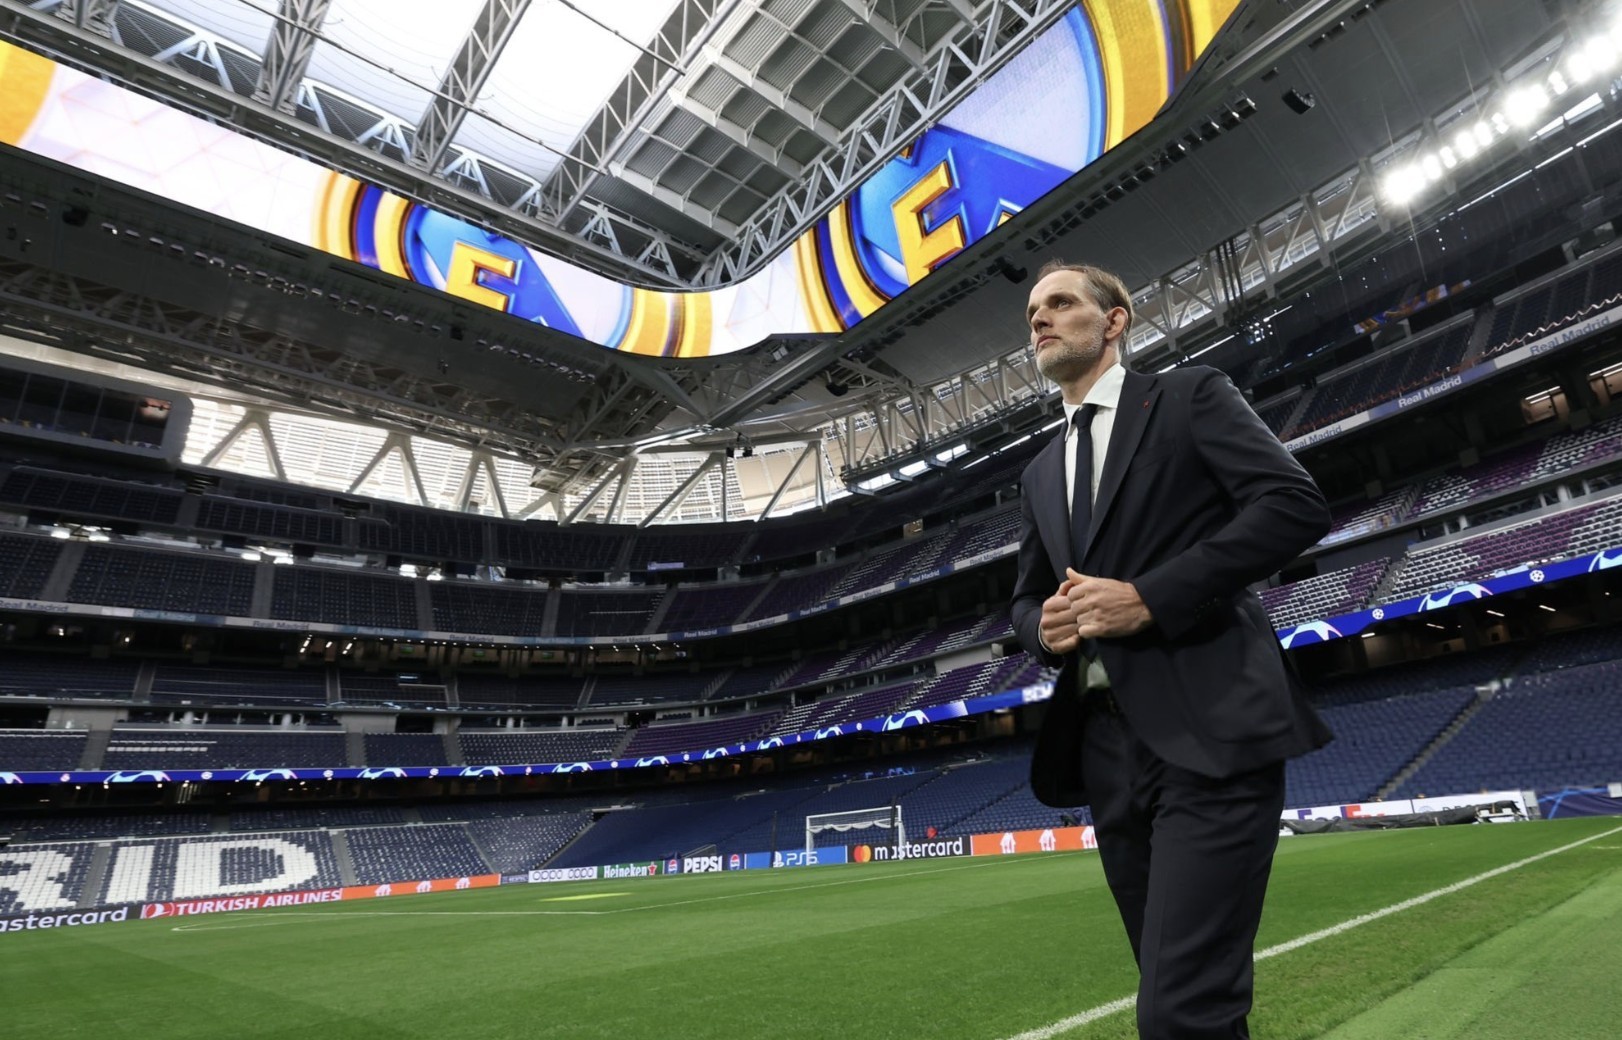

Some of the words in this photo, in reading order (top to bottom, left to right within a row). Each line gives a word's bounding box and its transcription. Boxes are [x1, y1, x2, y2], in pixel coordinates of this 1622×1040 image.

[1530, 337, 1559, 356] Real
[1562, 316, 1610, 342] Madrid
[1398, 392, 1422, 408] Real
[1423, 375, 1462, 398] Madrid
[1286, 438, 1307, 452] Real
[1308, 425, 1342, 445] Madrid
[909, 576, 921, 585] Real
[921, 569, 940, 581] Madrid
[604, 863, 648, 879] Heineken
[684, 856, 723, 874] PEPSI
[176, 896, 259, 916] TURKISH
[263, 888, 340, 908] AIRLINES
